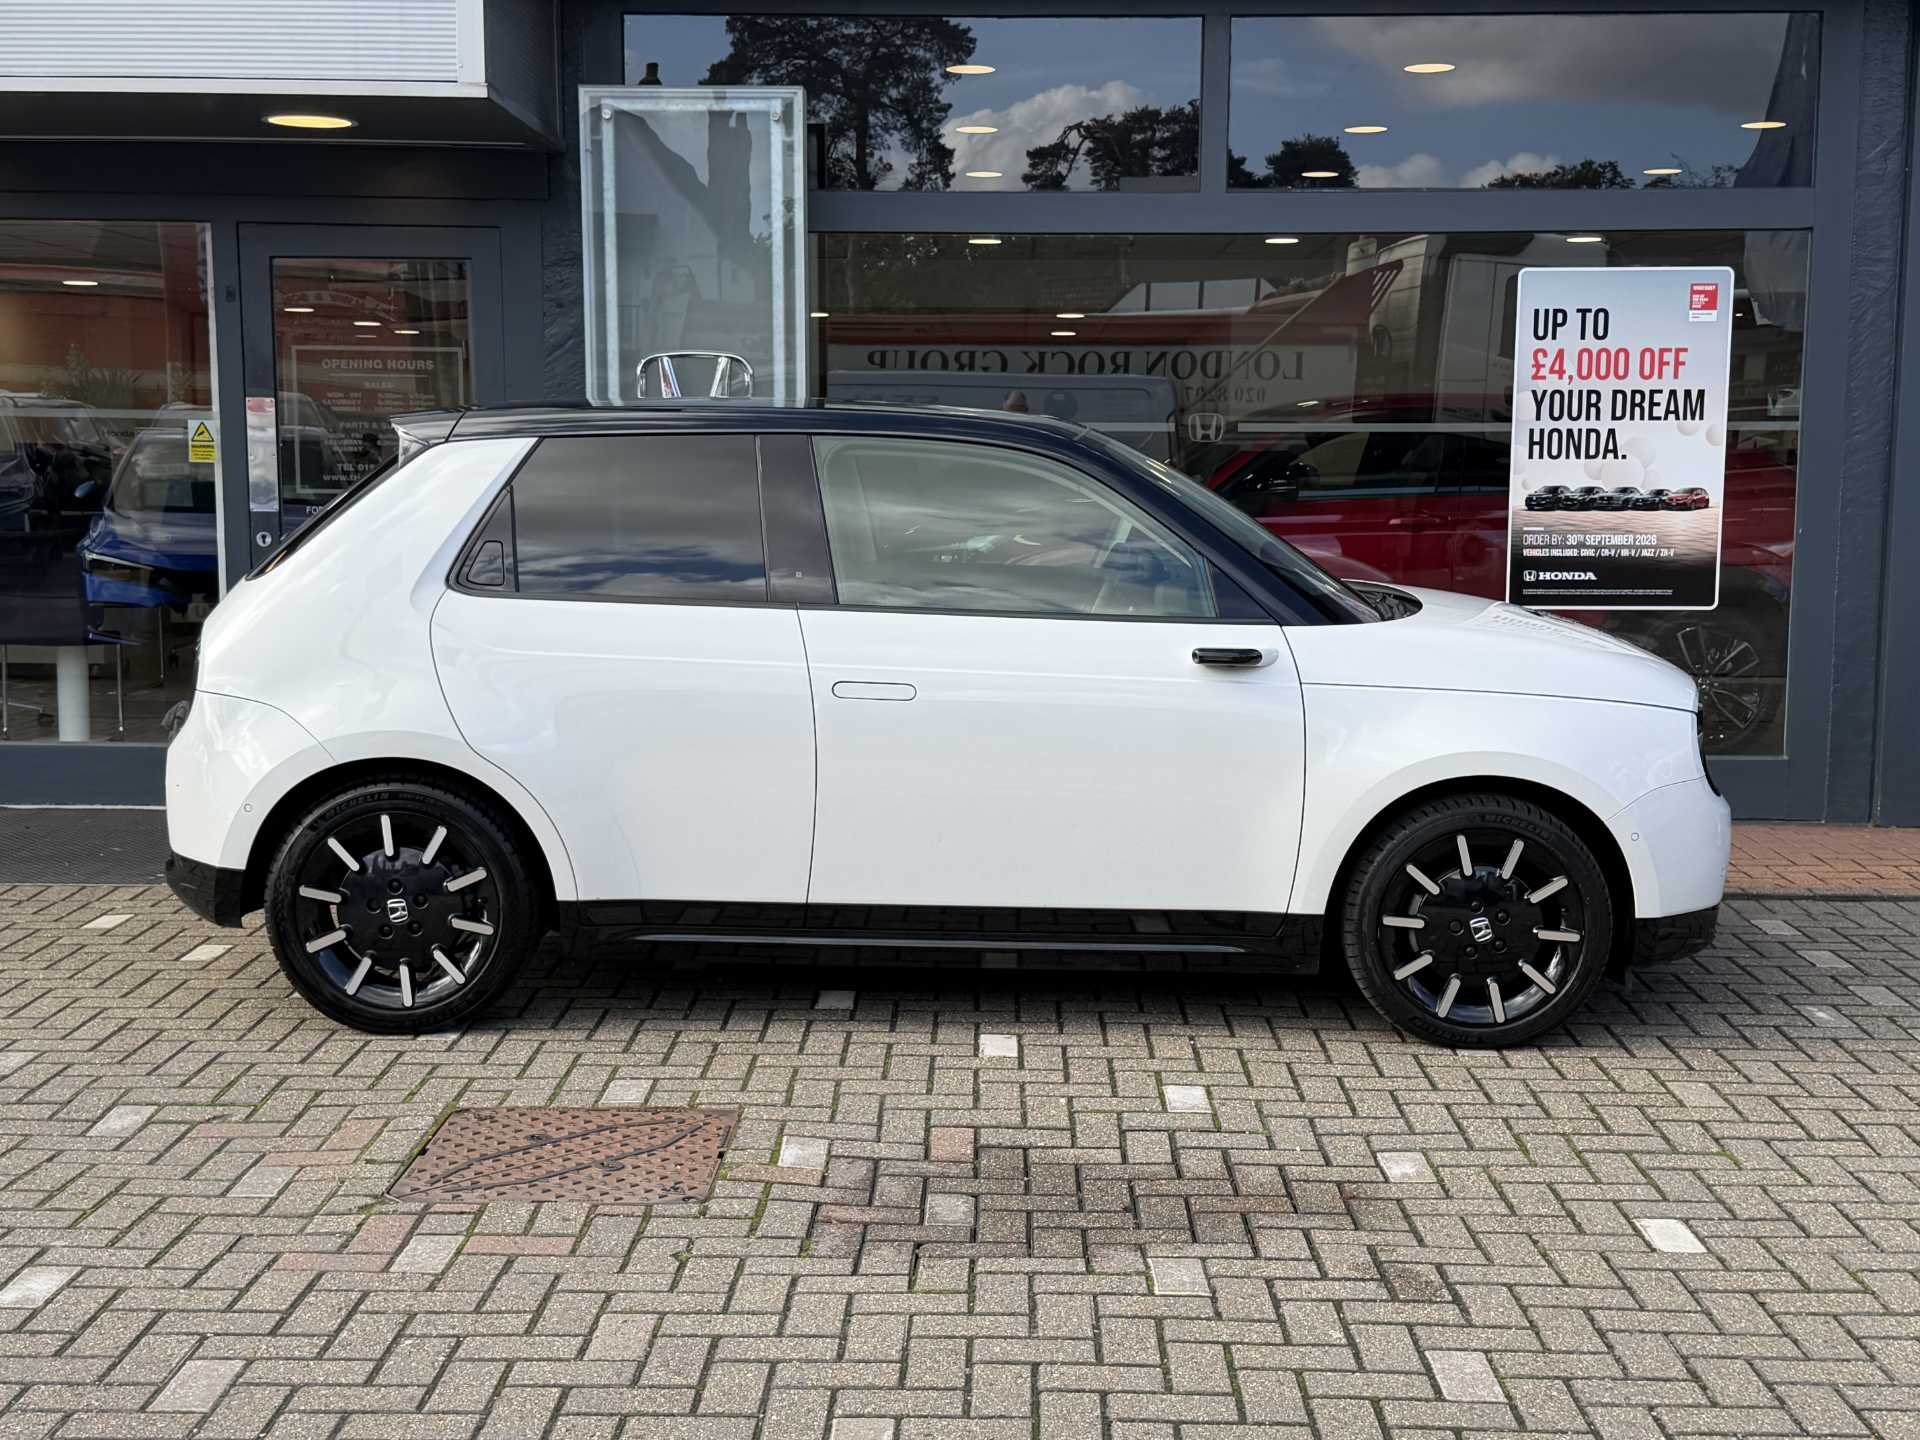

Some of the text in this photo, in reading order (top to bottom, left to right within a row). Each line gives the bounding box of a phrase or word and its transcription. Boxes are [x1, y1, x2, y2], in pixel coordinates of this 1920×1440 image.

[1533, 308, 1610, 340] UP TO
[322, 359, 434, 370] OPENING HOURS
[1531, 347, 1689, 385] £4,000 OFF
[1531, 389, 1706, 421] YOUR DREAM
[1528, 428, 1628, 460] HONDA.
[337, 463, 355, 471] TEL
[1522, 534, 1550, 546] ORDER
[1551, 534, 1565, 546] BY:
[1585, 534, 1634, 546] SEPTEMBER
[1635, 534, 1657, 546] 2026
[1522, 548, 1549, 557] VEHICLES
[1538, 572, 1598, 581] HONDA
